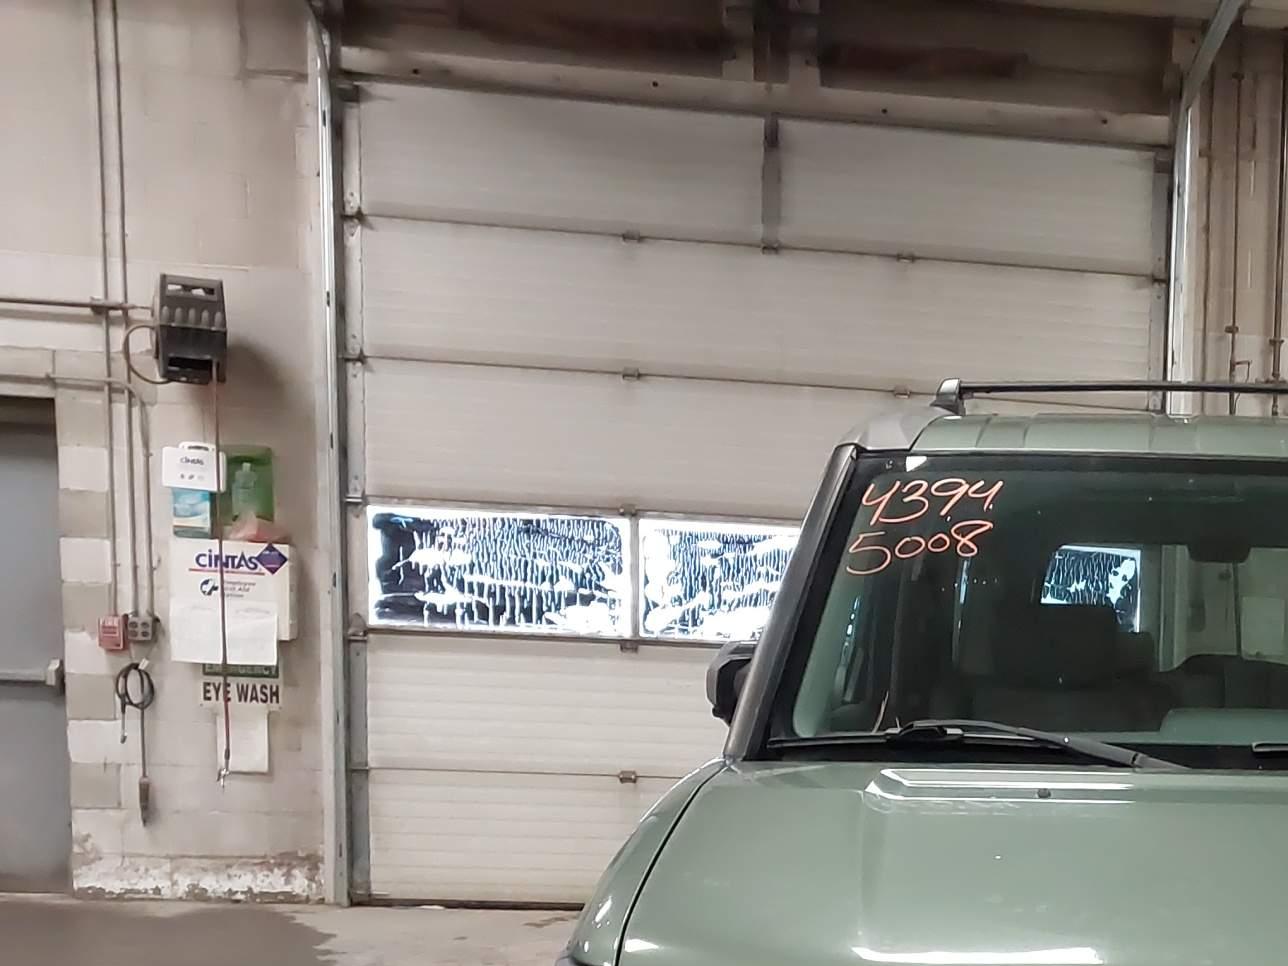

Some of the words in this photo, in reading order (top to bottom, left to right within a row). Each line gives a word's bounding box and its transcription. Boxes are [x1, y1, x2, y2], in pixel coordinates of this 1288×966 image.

[861, 478, 1004, 526] 4394
[846, 520, 994, 575] 5008
[203, 681, 232, 702] EYE
[236, 683, 280, 704] WASH
